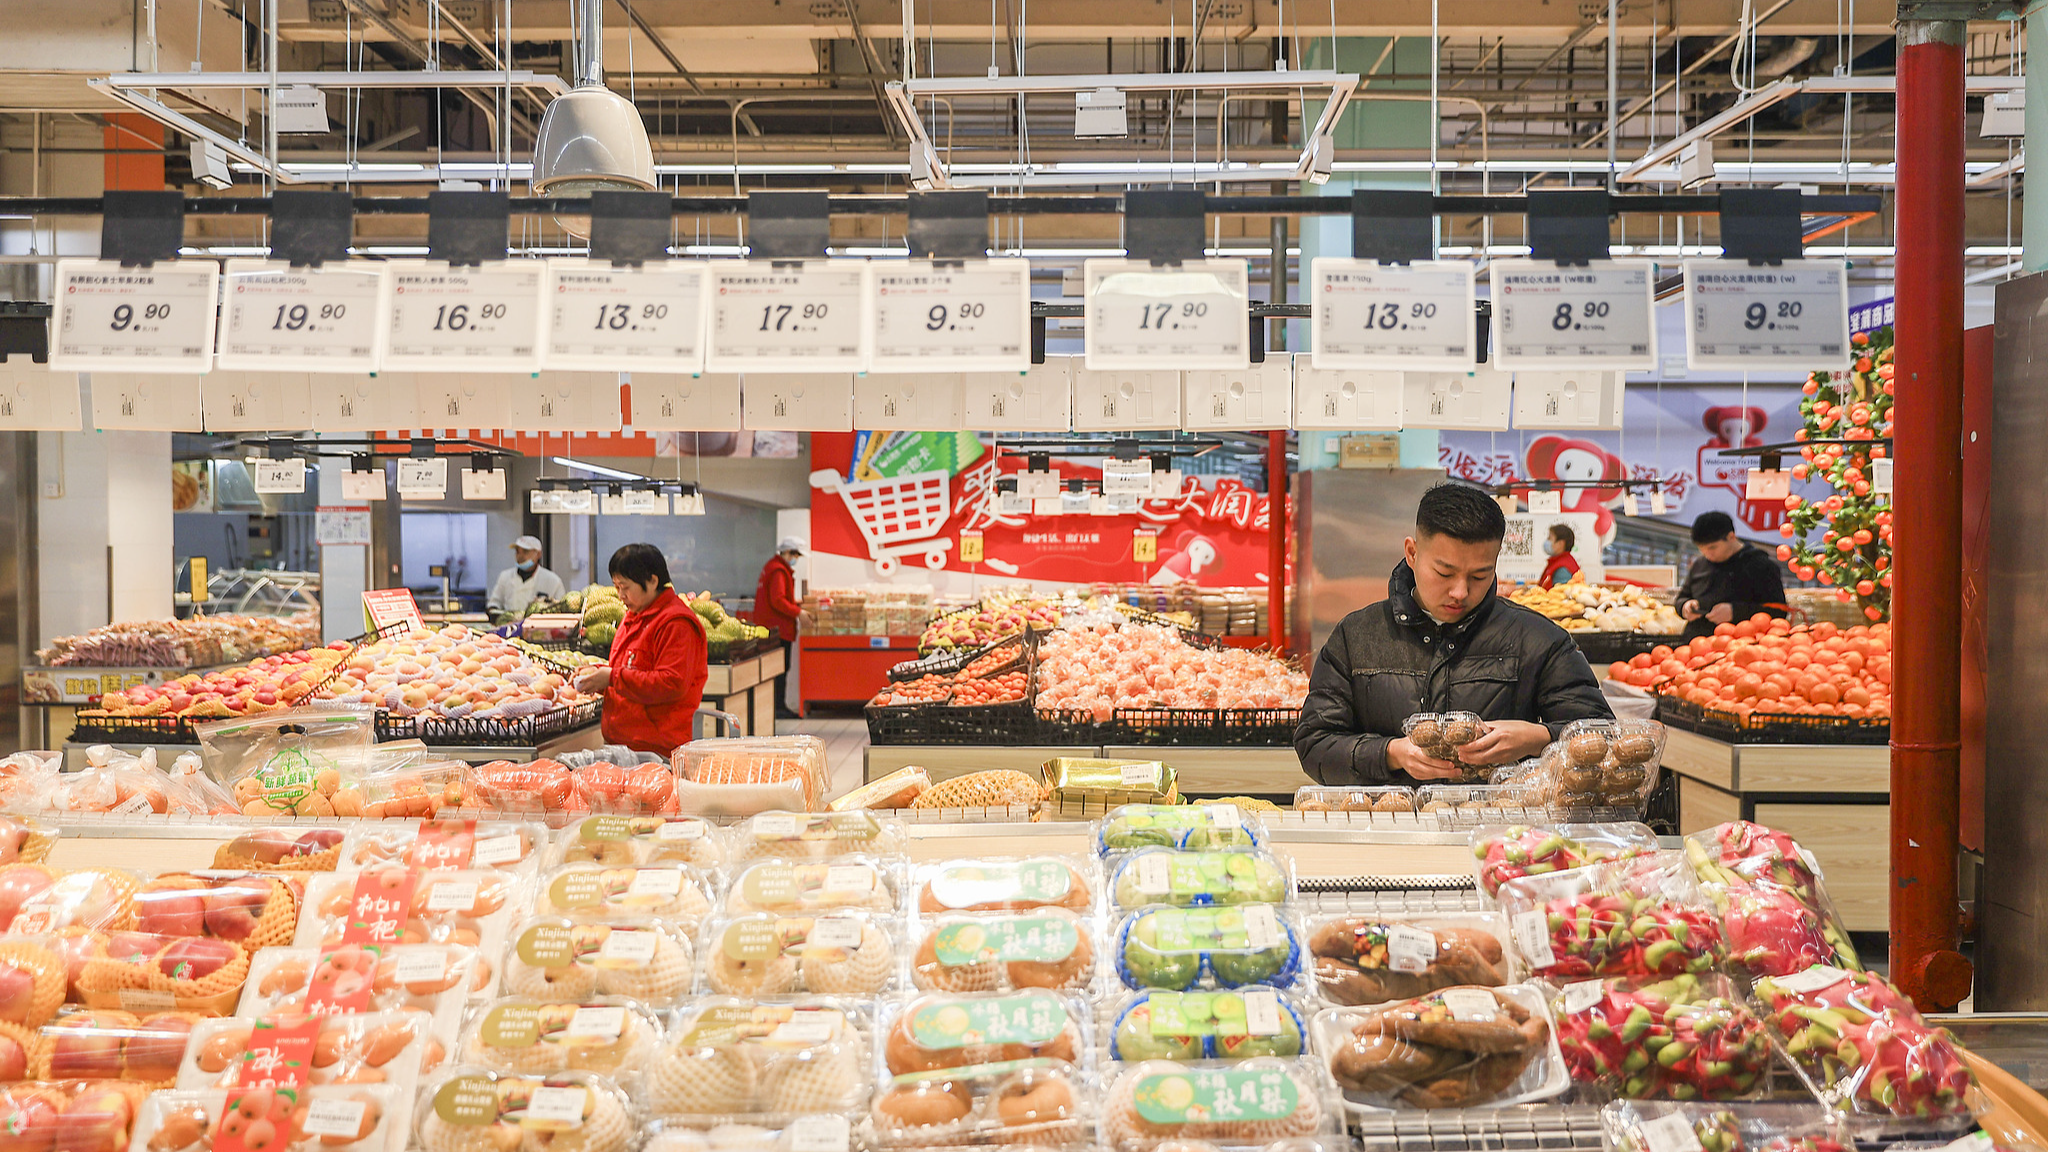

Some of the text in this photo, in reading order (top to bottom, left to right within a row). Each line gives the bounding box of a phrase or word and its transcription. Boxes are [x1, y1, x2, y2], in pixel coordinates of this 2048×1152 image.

[110, 303, 171, 332] 9.90
[272, 304, 346, 332] 19.90
[433, 303, 507, 332] 16.90
[594, 303, 668, 332] 13.90
[759, 303, 829, 332] 17.90
[926, 302, 985, 332] 9.90
[1139, 302, 1207, 331] 17.90
[1363, 302, 1437, 331] 13.90
[1552, 301, 1610, 331] 8.90
[1744, 301, 1802, 331] 9.20
[567, 872, 602, 883] Xinjiang
[536, 926, 574, 938] Xinjiang
[503, 1007, 543, 1020] Xinjiang
[988, 1006, 1056, 1038] 秋月梨
[458, 1079, 501, 1093] Xinjiang
[1213, 1080, 1288, 1115] 秋月梨
